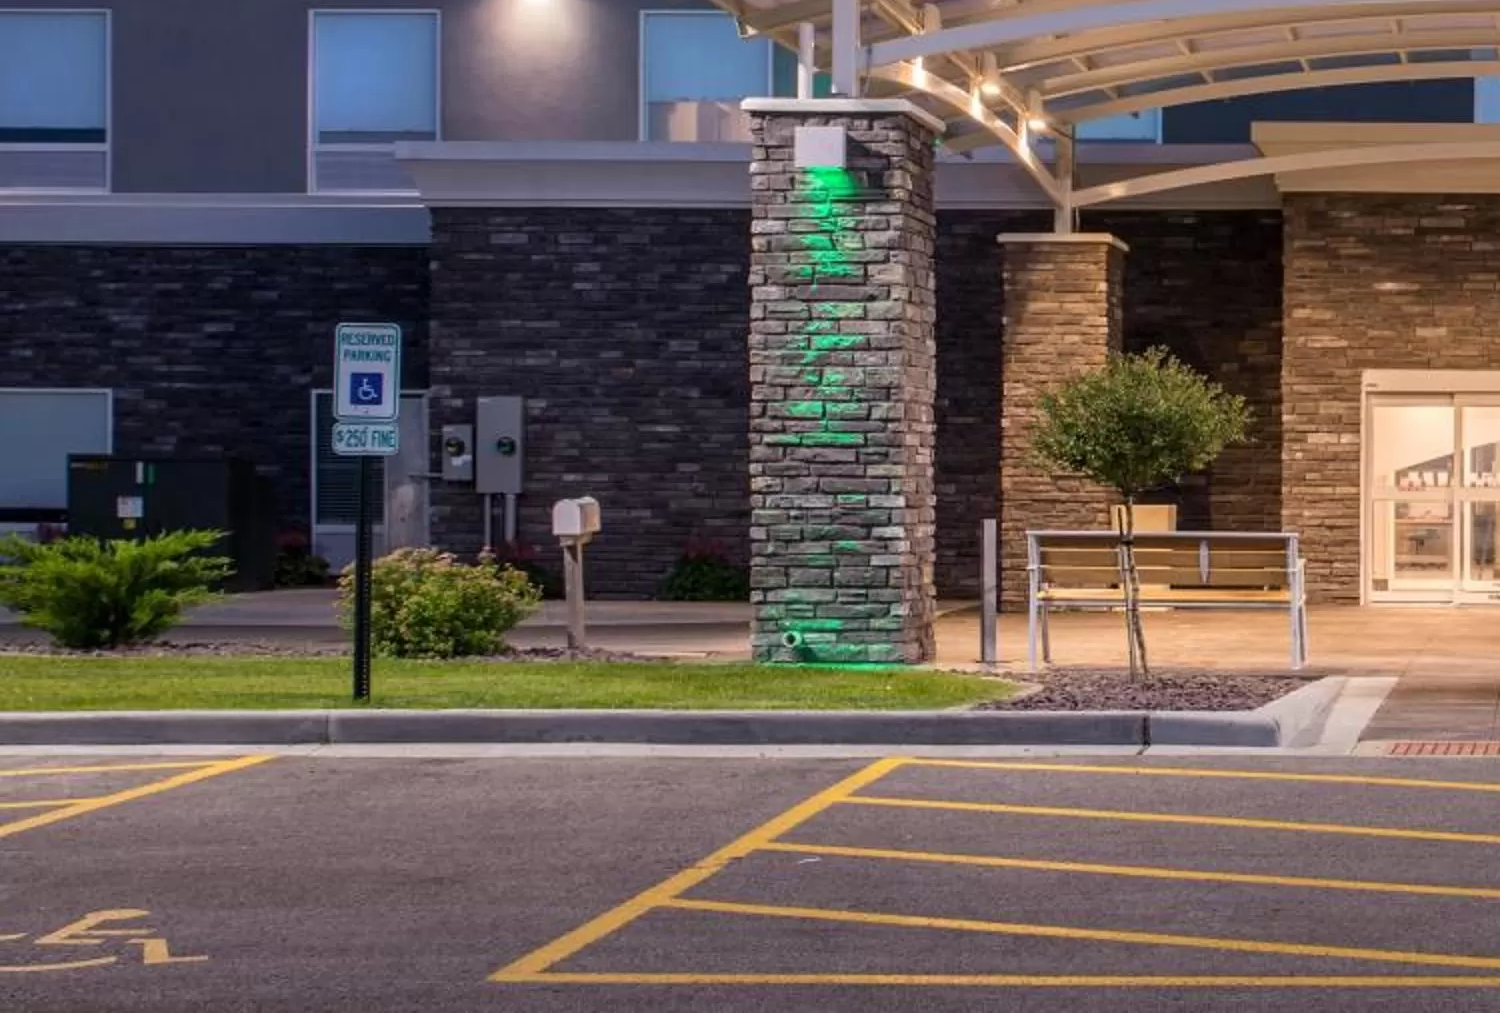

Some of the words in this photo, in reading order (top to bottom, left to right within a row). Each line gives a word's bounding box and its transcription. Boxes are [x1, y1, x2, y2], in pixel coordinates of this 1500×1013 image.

[341, 332, 395, 346] RESERVED
[343, 348, 392, 362] PARKING
[336, 429, 368, 448] $250
[371, 429, 396, 448] FINE
